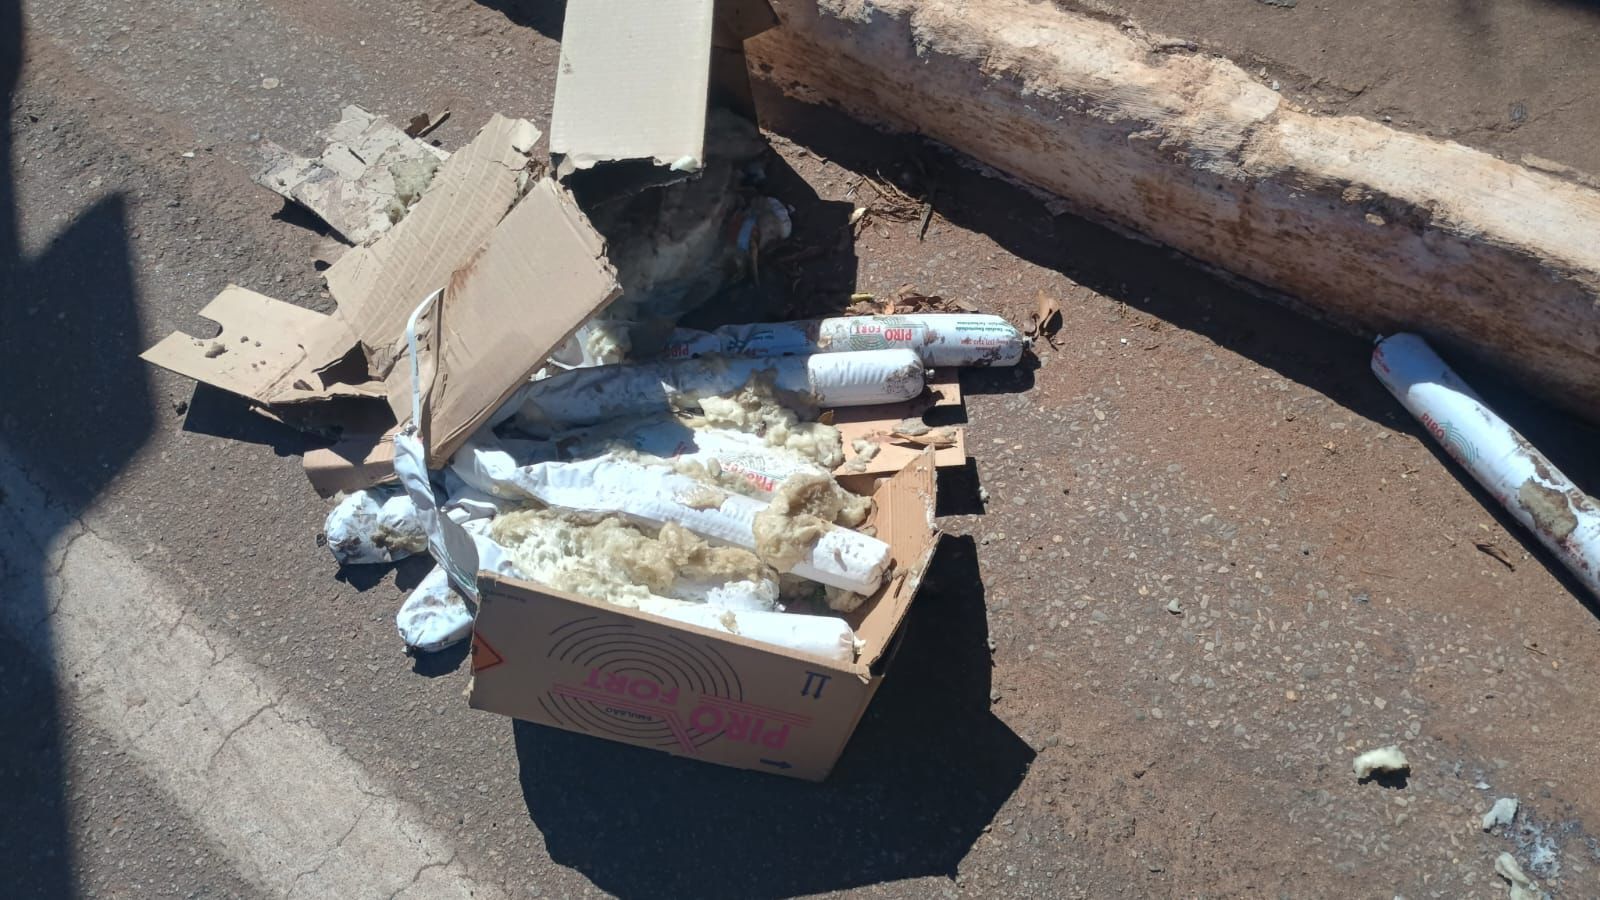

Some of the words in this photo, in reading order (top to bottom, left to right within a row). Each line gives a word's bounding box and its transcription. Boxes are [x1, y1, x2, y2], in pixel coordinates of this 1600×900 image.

[856, 324, 881, 334] FORT
[885, 328, 912, 341] PIRO
[1421, 412, 1445, 439] PIRO
[747, 473, 774, 492] PIRO
[583, 668, 681, 704] FORT
[693, 707, 792, 749] PIRO
